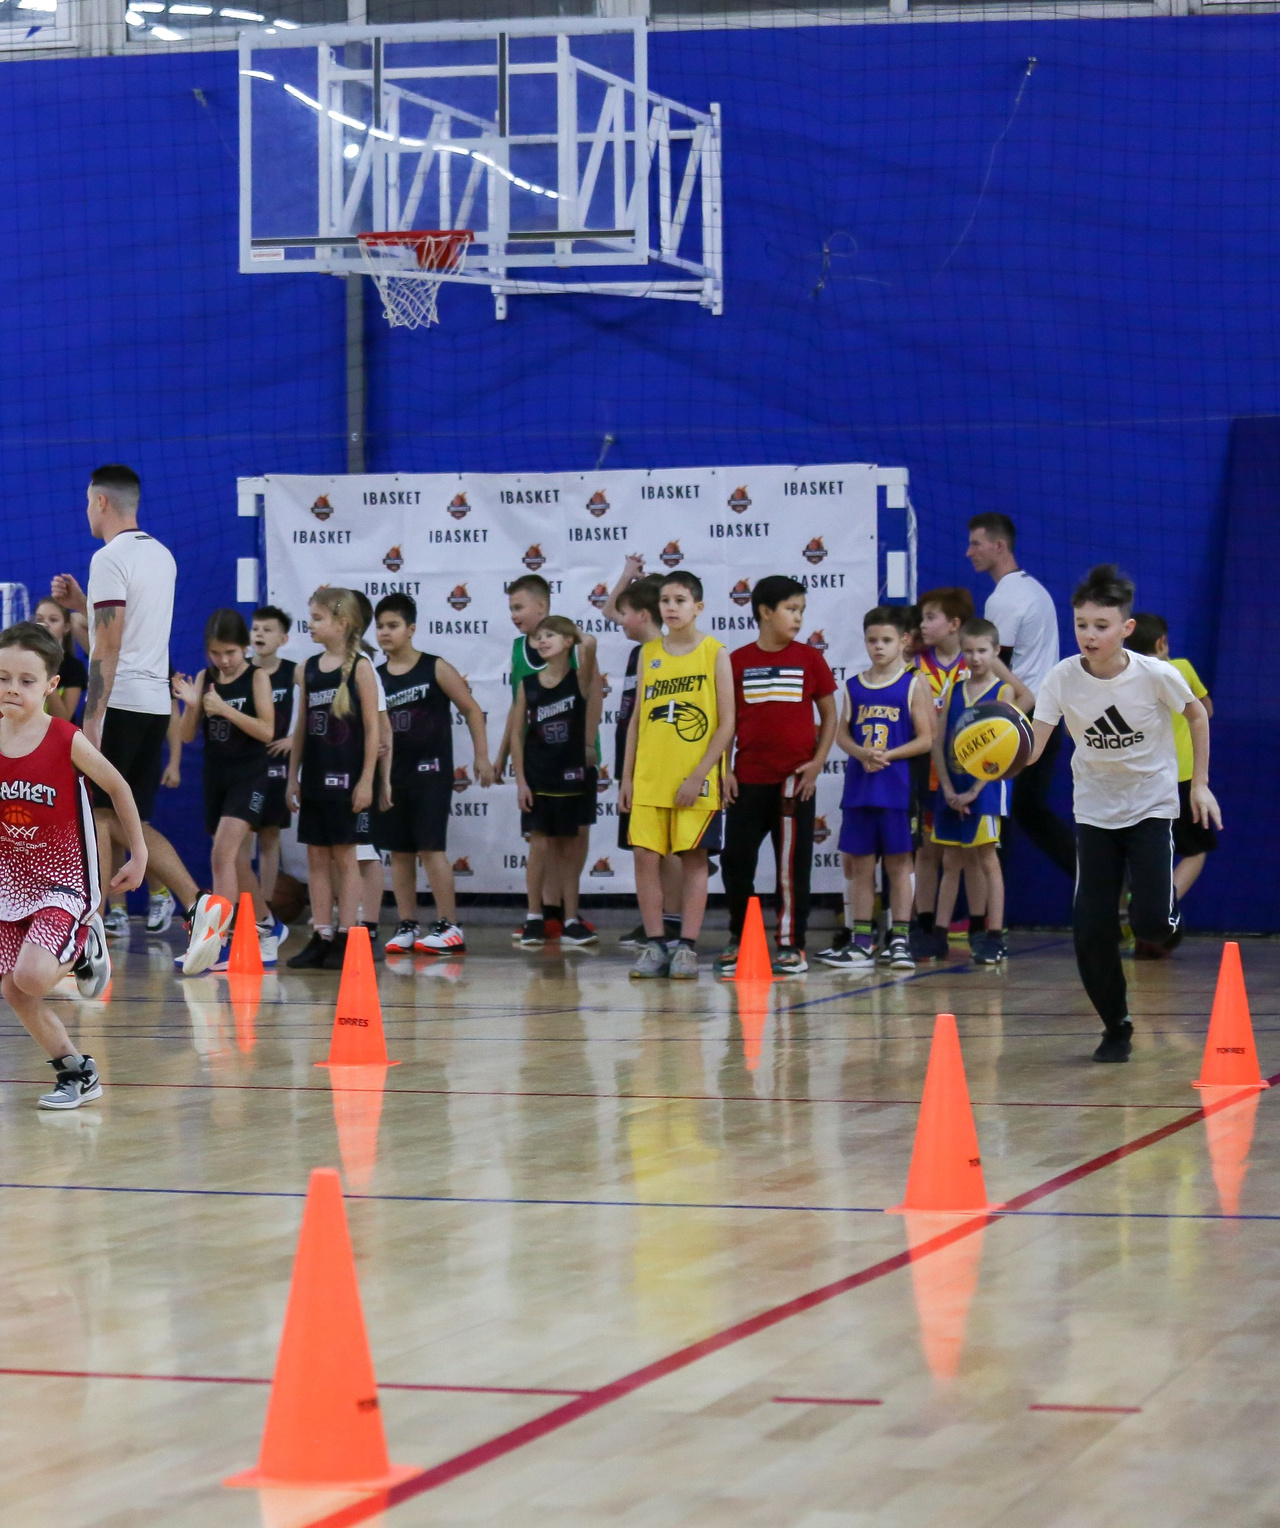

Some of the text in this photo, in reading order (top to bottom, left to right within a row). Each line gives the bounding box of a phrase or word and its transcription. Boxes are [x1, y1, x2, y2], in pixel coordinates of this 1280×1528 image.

[641, 485, 700, 500] IBASKET
[784, 481, 844, 496] IBASKET
[363, 491, 421, 505] IBASKET
[500, 490, 560, 504] IBASKET
[293, 530, 352, 544] IBASKET
[429, 529, 488, 543] IBASKET
[569, 526, 628, 541] IBASKET
[710, 523, 770, 538] IBASKET
[792, 574, 845, 588] ASKET
[365, 582, 421, 596] IBASKET
[429, 621, 488, 634] IBASKET
[576, 619, 620, 633] BASKE
[712, 616, 756, 631] IBASK
[666, 699, 675, 723] 1
[1084, 731, 1144, 749] adidas
[450, 803, 488, 816] SKET
[26, 842, 47, 850] CAMP
[338, 1017, 369, 1028] TORRES
